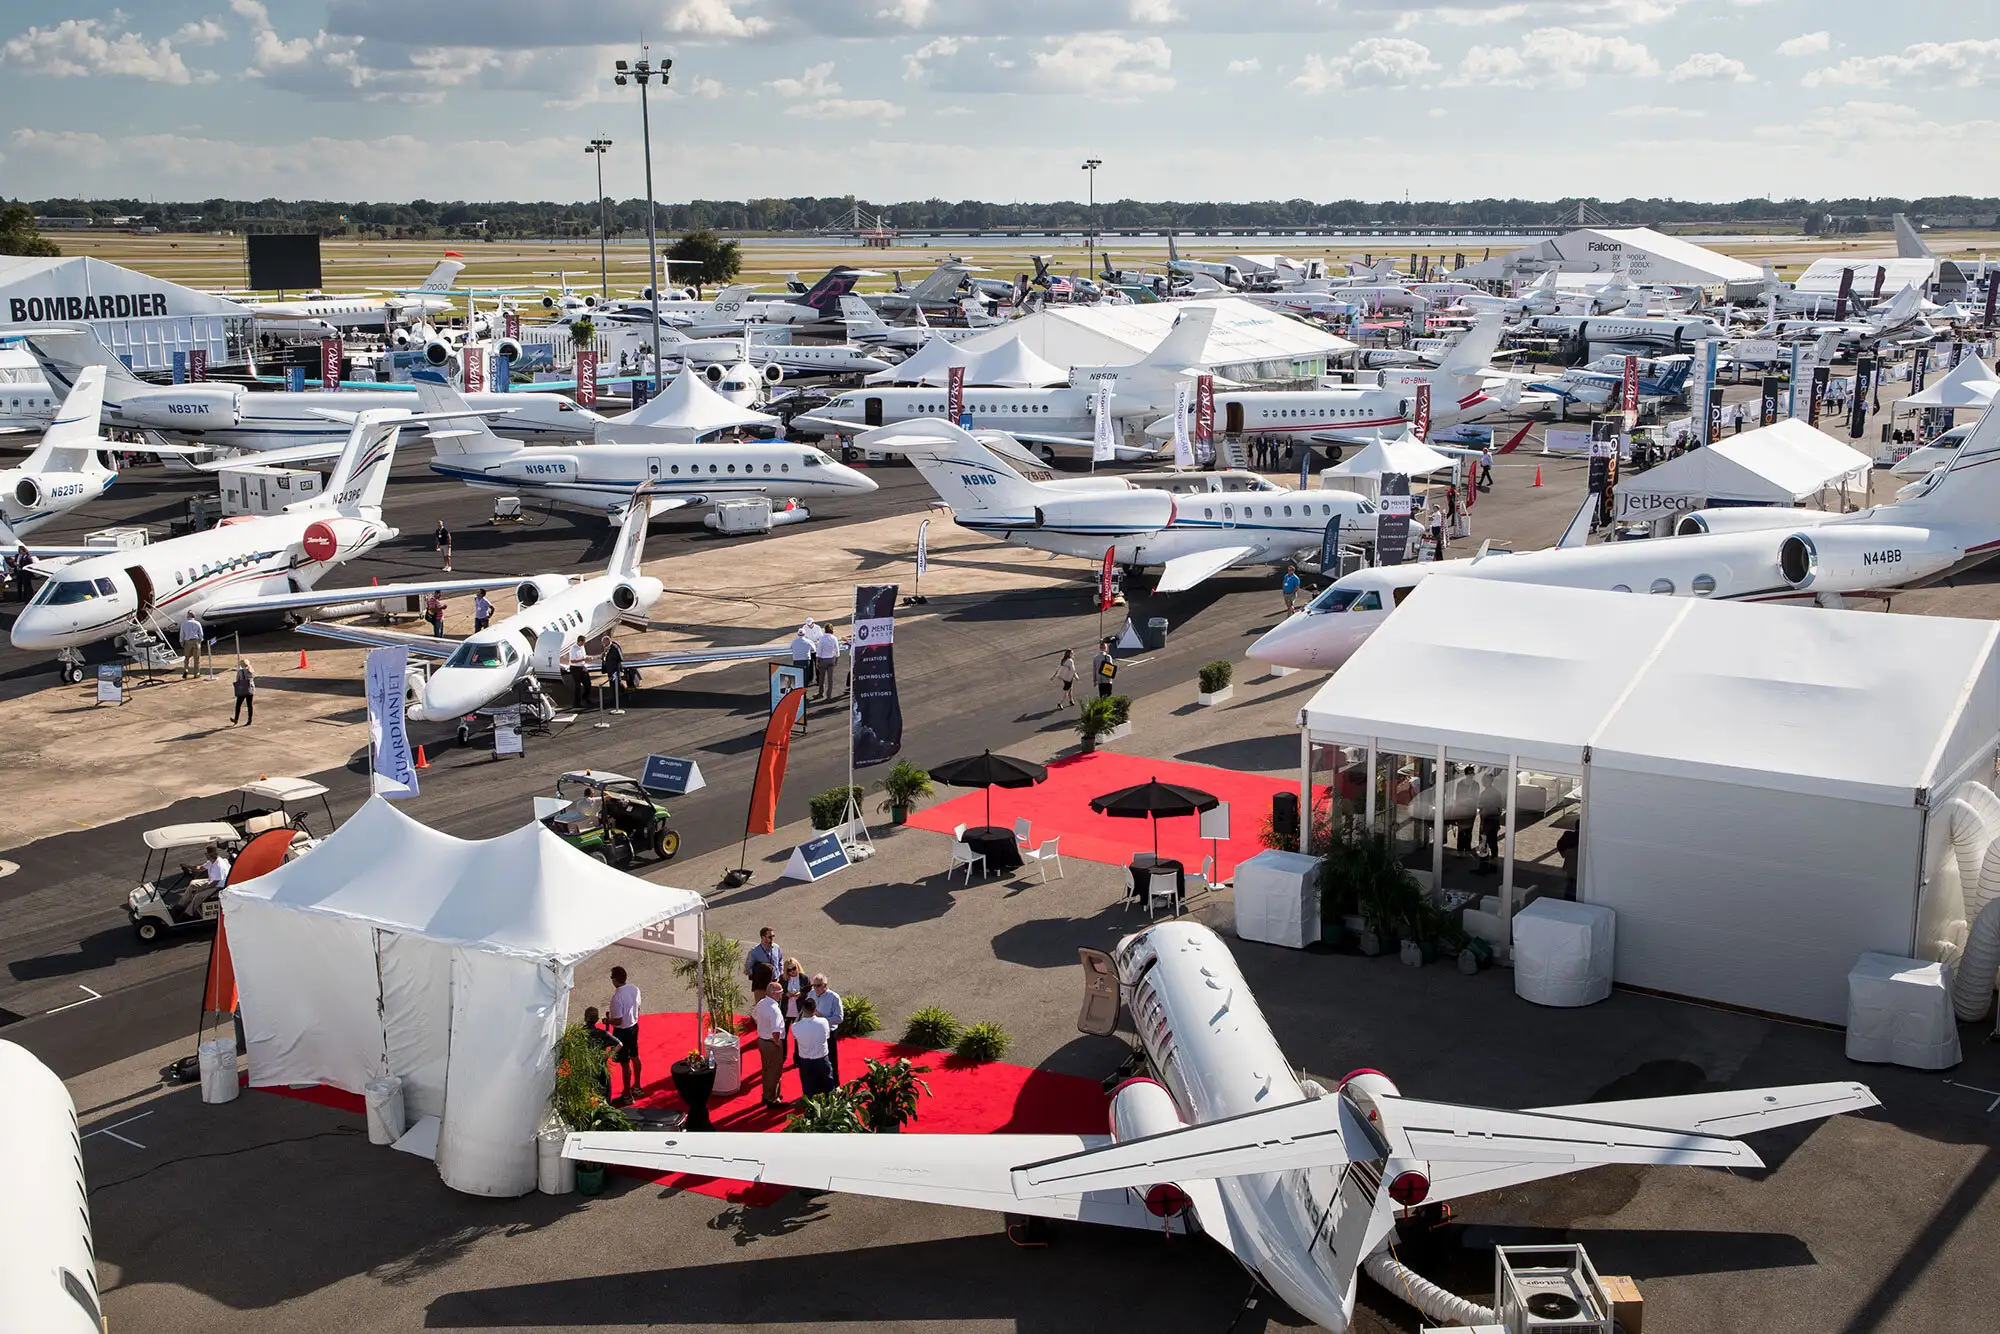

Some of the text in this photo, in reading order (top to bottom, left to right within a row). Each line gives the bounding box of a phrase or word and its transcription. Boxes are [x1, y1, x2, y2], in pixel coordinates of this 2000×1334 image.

[1588, 242, 1622, 251] Falcon
[427, 283, 448, 291] 7000
[9, 293, 168, 322] BOMBARDIER
[714, 302, 741, 312] 650
[193, 356, 203, 382] VPRO
[326, 347, 339, 388] AVPRO
[467, 355, 482, 393] AVPRO
[581, 359, 593, 403] AVPRO
[949, 376, 961, 424] AVPRO
[168, 404, 210, 414] N897AT
[1199, 384, 1211, 438] AVPRO
[525, 462, 567, 475] N184TB
[51, 483, 84, 498] N629TG
[301, 481, 312, 490] CAT
[332, 488, 361, 504] N243PG
[1863, 549, 1902, 566] N44BB
[858, 673, 893, 681] TECHNOLOGY
[860, 691, 892, 699] SOLUTIONS
